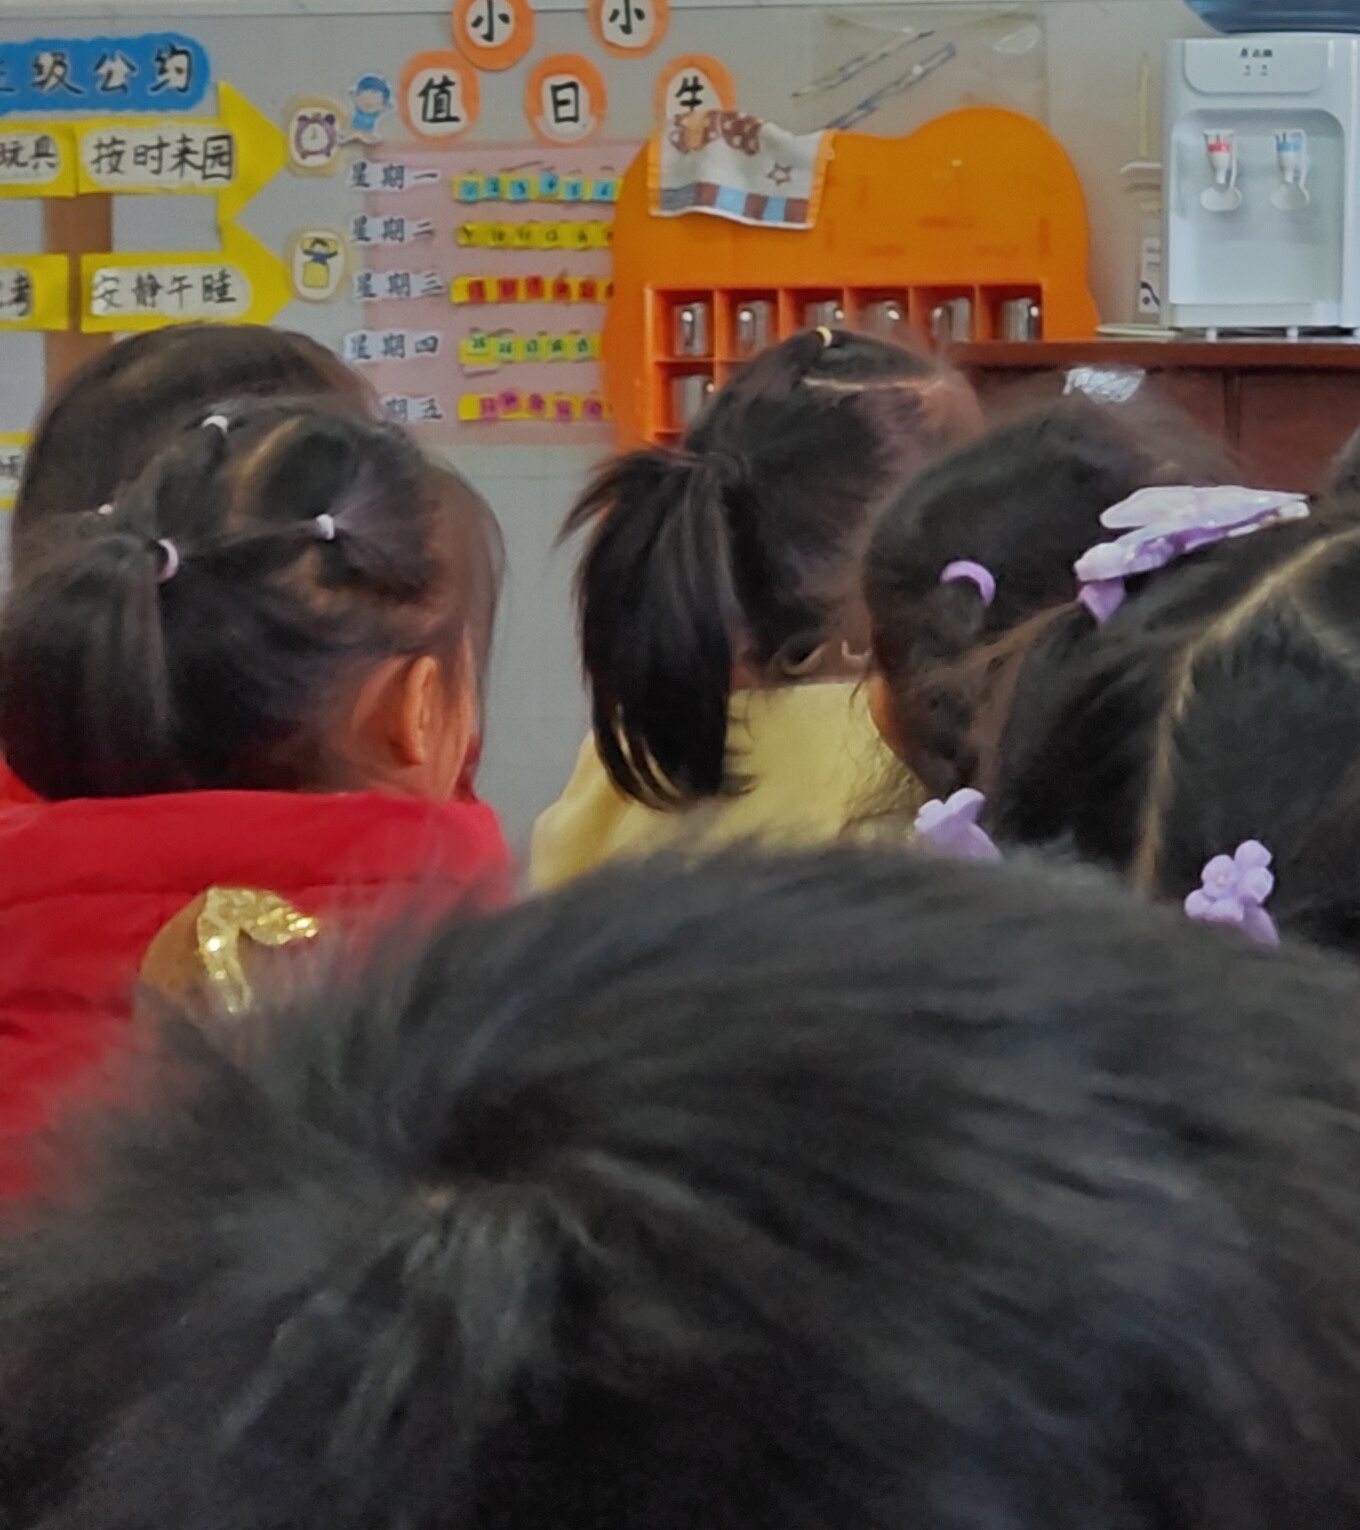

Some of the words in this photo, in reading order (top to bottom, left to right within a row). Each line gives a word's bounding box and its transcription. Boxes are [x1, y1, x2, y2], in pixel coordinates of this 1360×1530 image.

[91, 132, 233, 181] 按时来园
[351, 161, 438, 190] 星期一
[352, 215, 434, 243] 星期二
[0, 271, 32, 317] 考
[94, 269, 238, 311] 安静午睡
[356, 272, 444, 298] 星期三
[350, 333, 439, 360] 星期四
